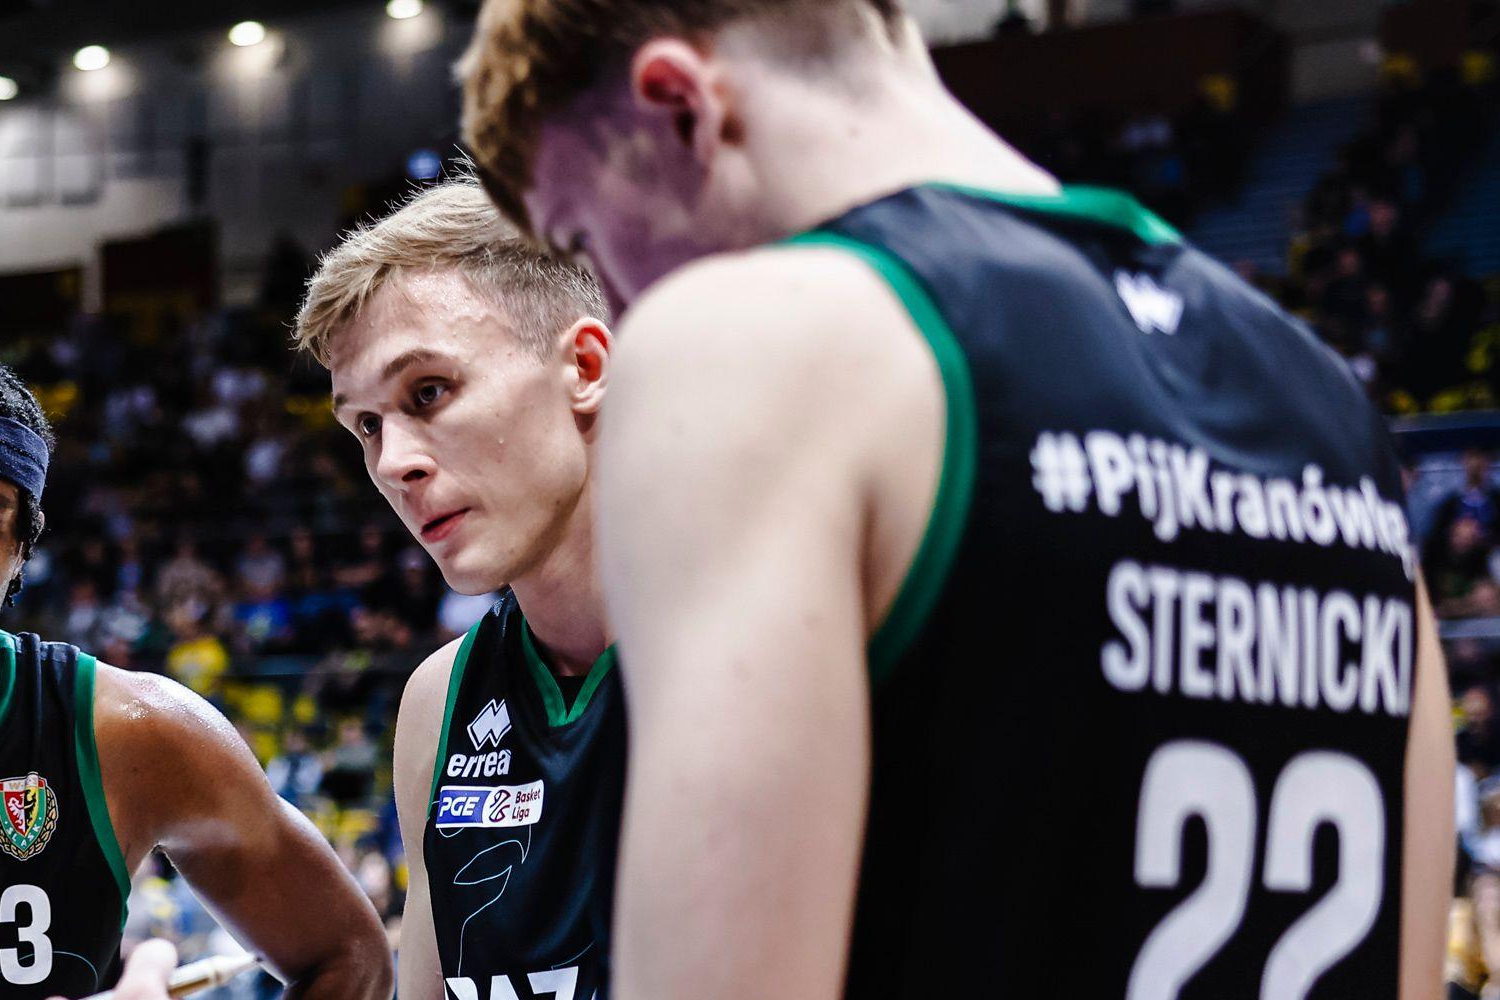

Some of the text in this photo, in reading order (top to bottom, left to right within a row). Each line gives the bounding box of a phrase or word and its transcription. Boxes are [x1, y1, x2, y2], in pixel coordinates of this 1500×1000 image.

[1101, 559, 1412, 716] STERNICKI
[439, 796, 480, 817] PGE
[515, 789, 541, 804] Basket
[512, 807, 530, 821] Liga
[0, 884, 54, 985] 3
